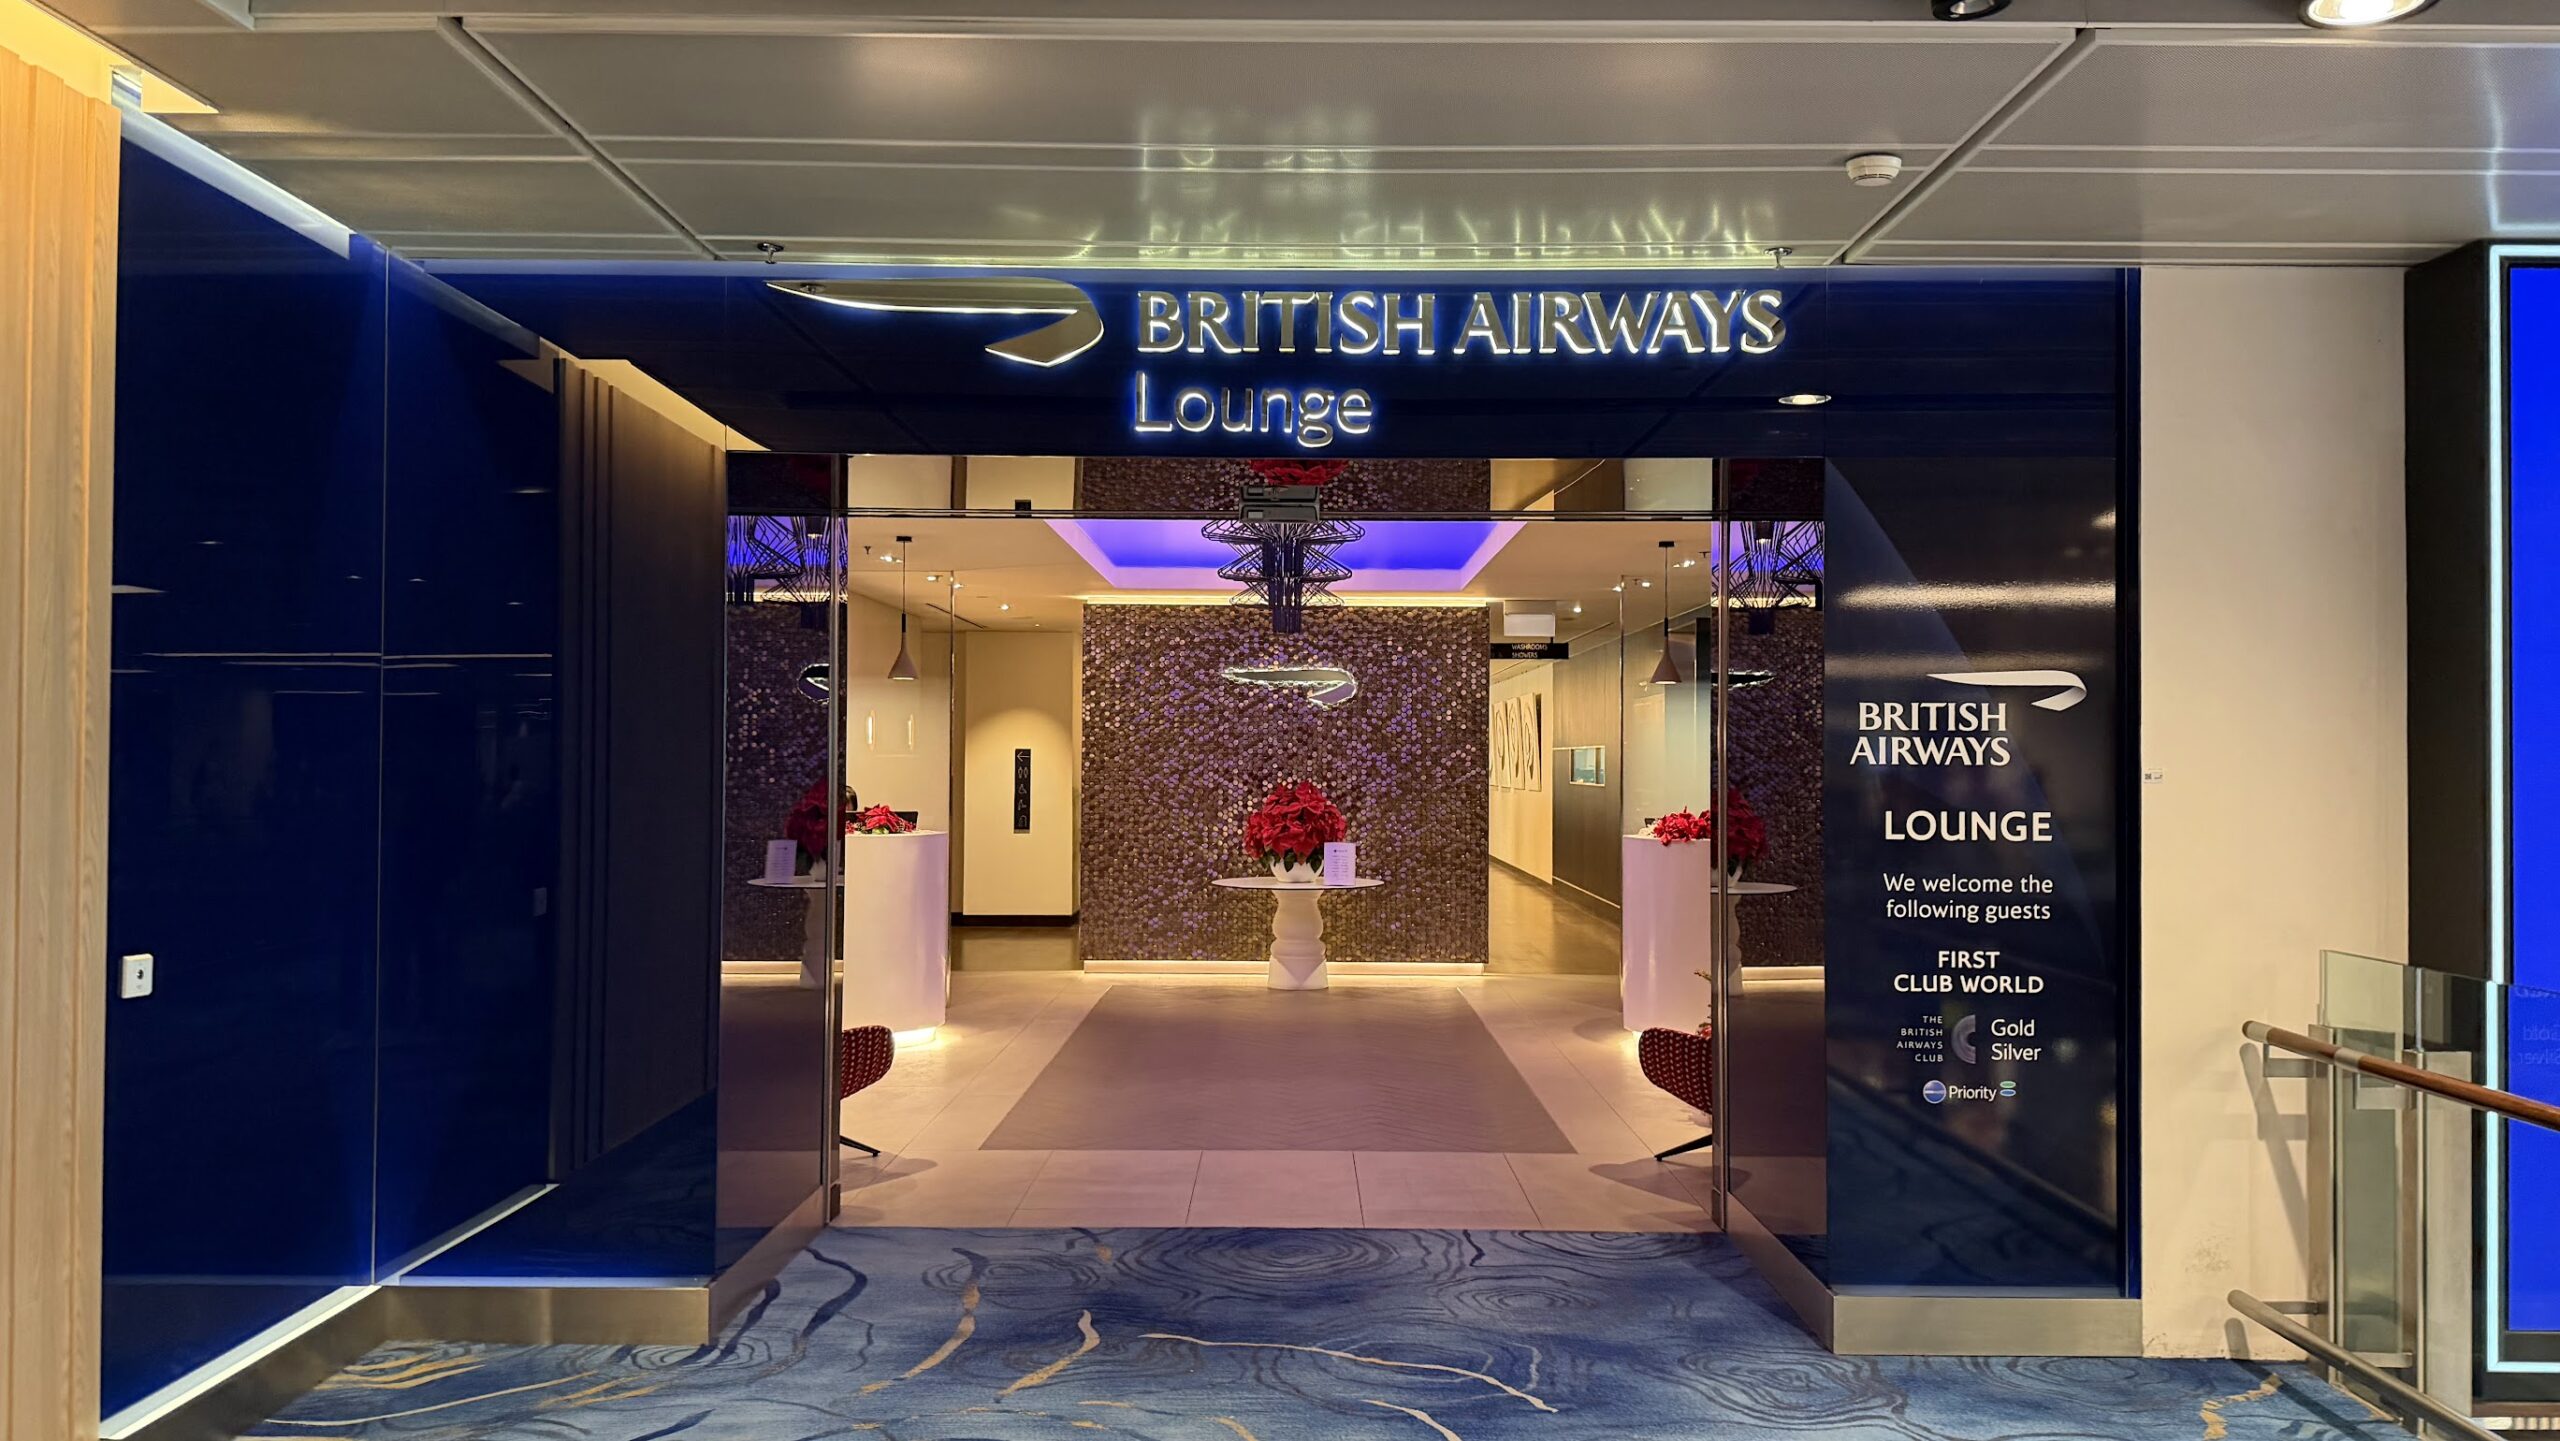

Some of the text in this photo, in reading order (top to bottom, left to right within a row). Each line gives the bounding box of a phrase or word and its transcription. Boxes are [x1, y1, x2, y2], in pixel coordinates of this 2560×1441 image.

[1137, 290, 1786, 355] BRITISH AIRWAYS
[1135, 370, 1372, 448] Lounge
[1511, 643, 1548, 651] WASHROOMS
[1511, 651, 1539, 659] SHOWERS
[1858, 702, 2007, 732] BRITISH
[1849, 736, 2011, 767] AIRWAYS
[1884, 810, 2053, 842] LOUNGE
[1883, 872, 2053, 894] We welcome the
[1886, 898, 2051, 924] following guests
[1938, 950, 2001, 969] FIRST
[1893, 974, 2044, 994] CLUB WORLD
[1922, 1015, 1943, 1024] THE
[1991, 1018, 2035, 1037] Gold
[1900, 1028, 1943, 1037] BRITISH
[1896, 1041, 1943, 1050] AIRWAYS
[1991, 1042, 2042, 1061] Silver
[1914, 1053, 1944, 1063] CLUB
[1948, 1085, 1997, 1102] Priority
